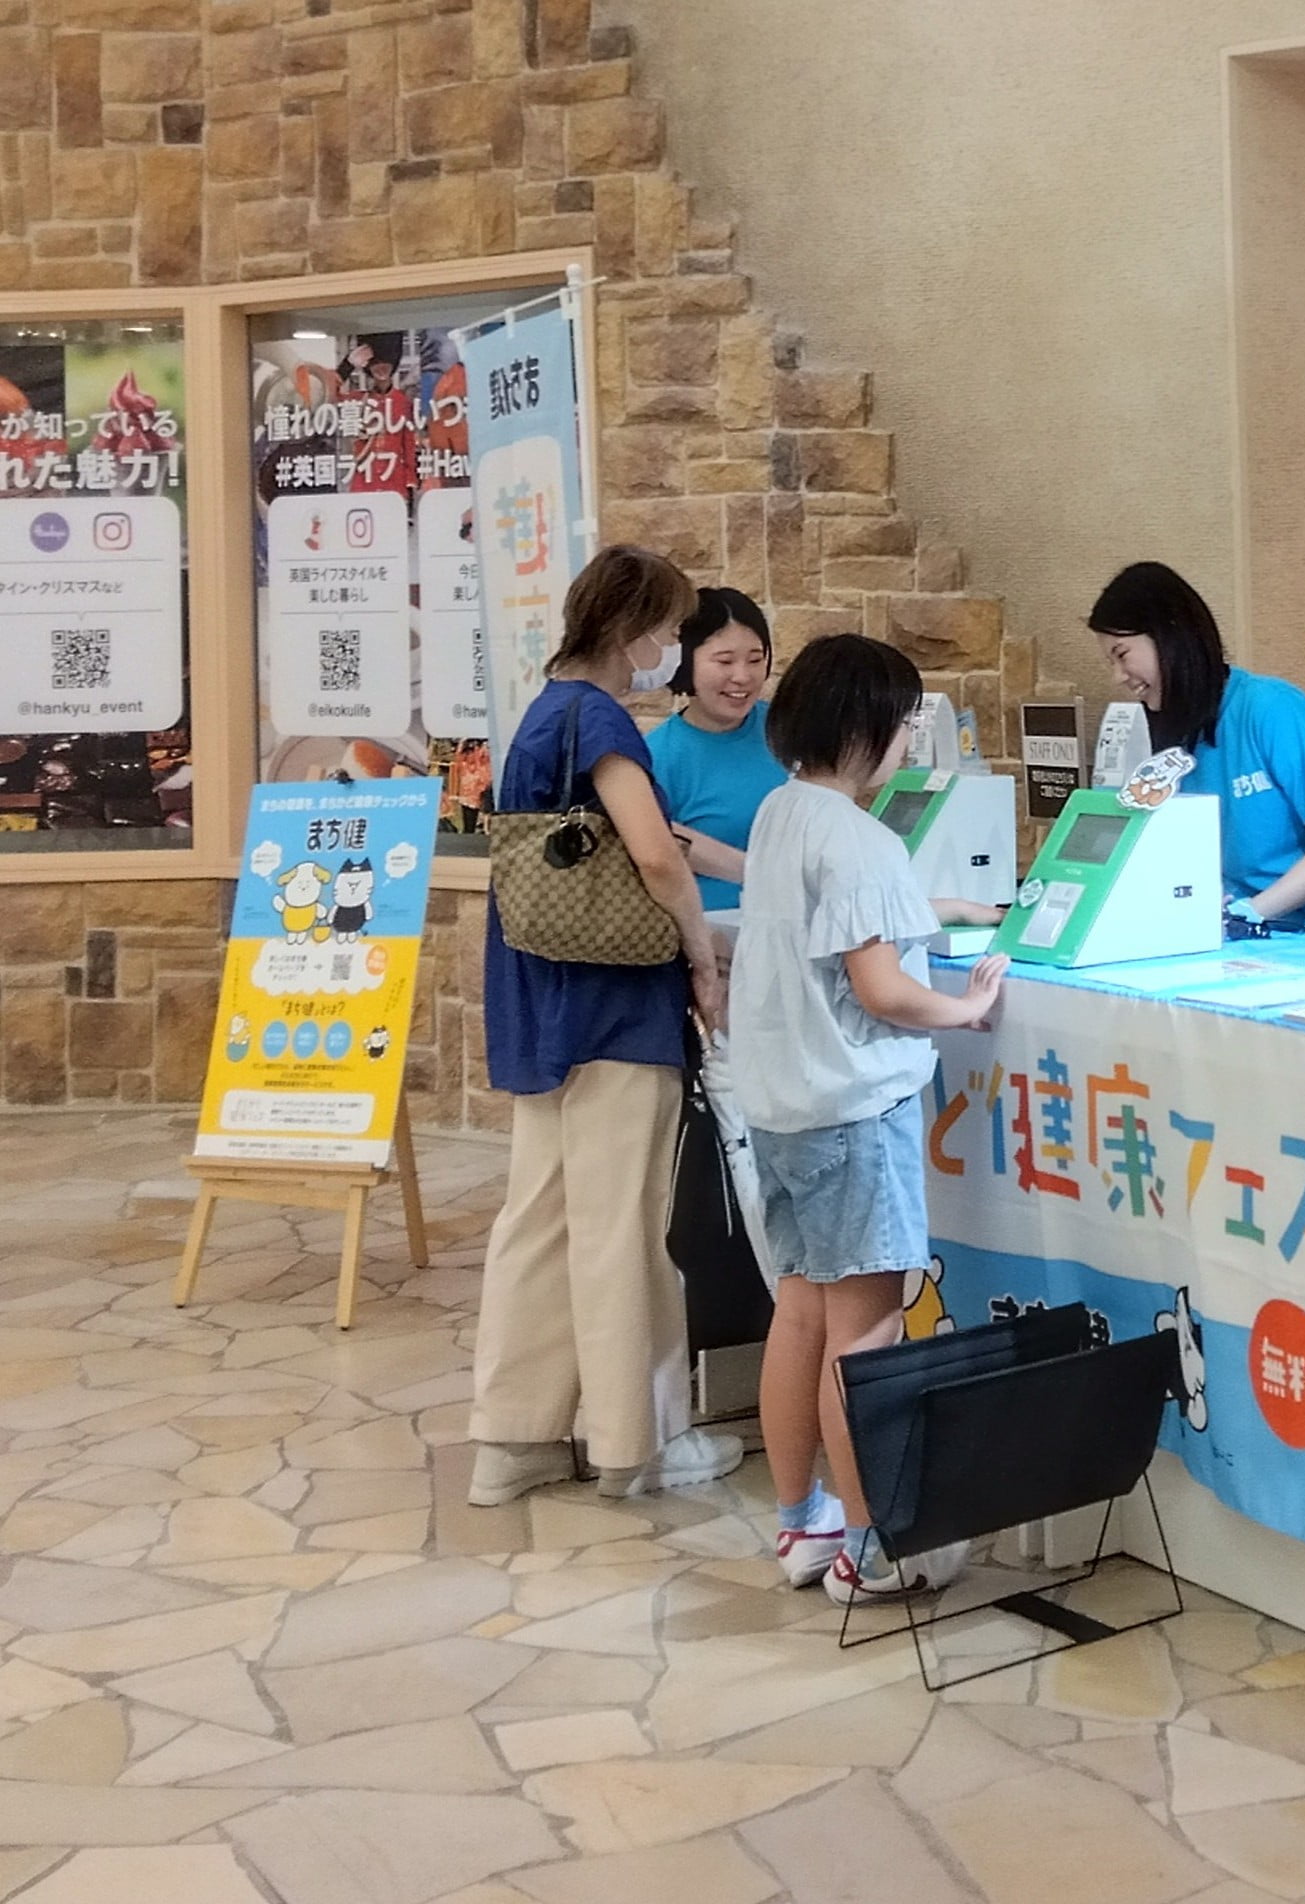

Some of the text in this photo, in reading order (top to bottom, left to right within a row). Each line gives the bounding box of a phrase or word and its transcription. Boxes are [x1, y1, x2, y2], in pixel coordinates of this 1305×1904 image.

[1, 409, 178, 440] が知っている
[264, 396, 469, 441] 憧れの暮らし、いつ
[275, 450, 399, 487] #英国ライフ
[289, 566, 388, 583] 英国ライフスタイルを
[308, 587, 370, 604] 楽しむ暮らし
[17, 697, 144, 716] @hankyu_event
[306, 818, 368, 851] まち健
